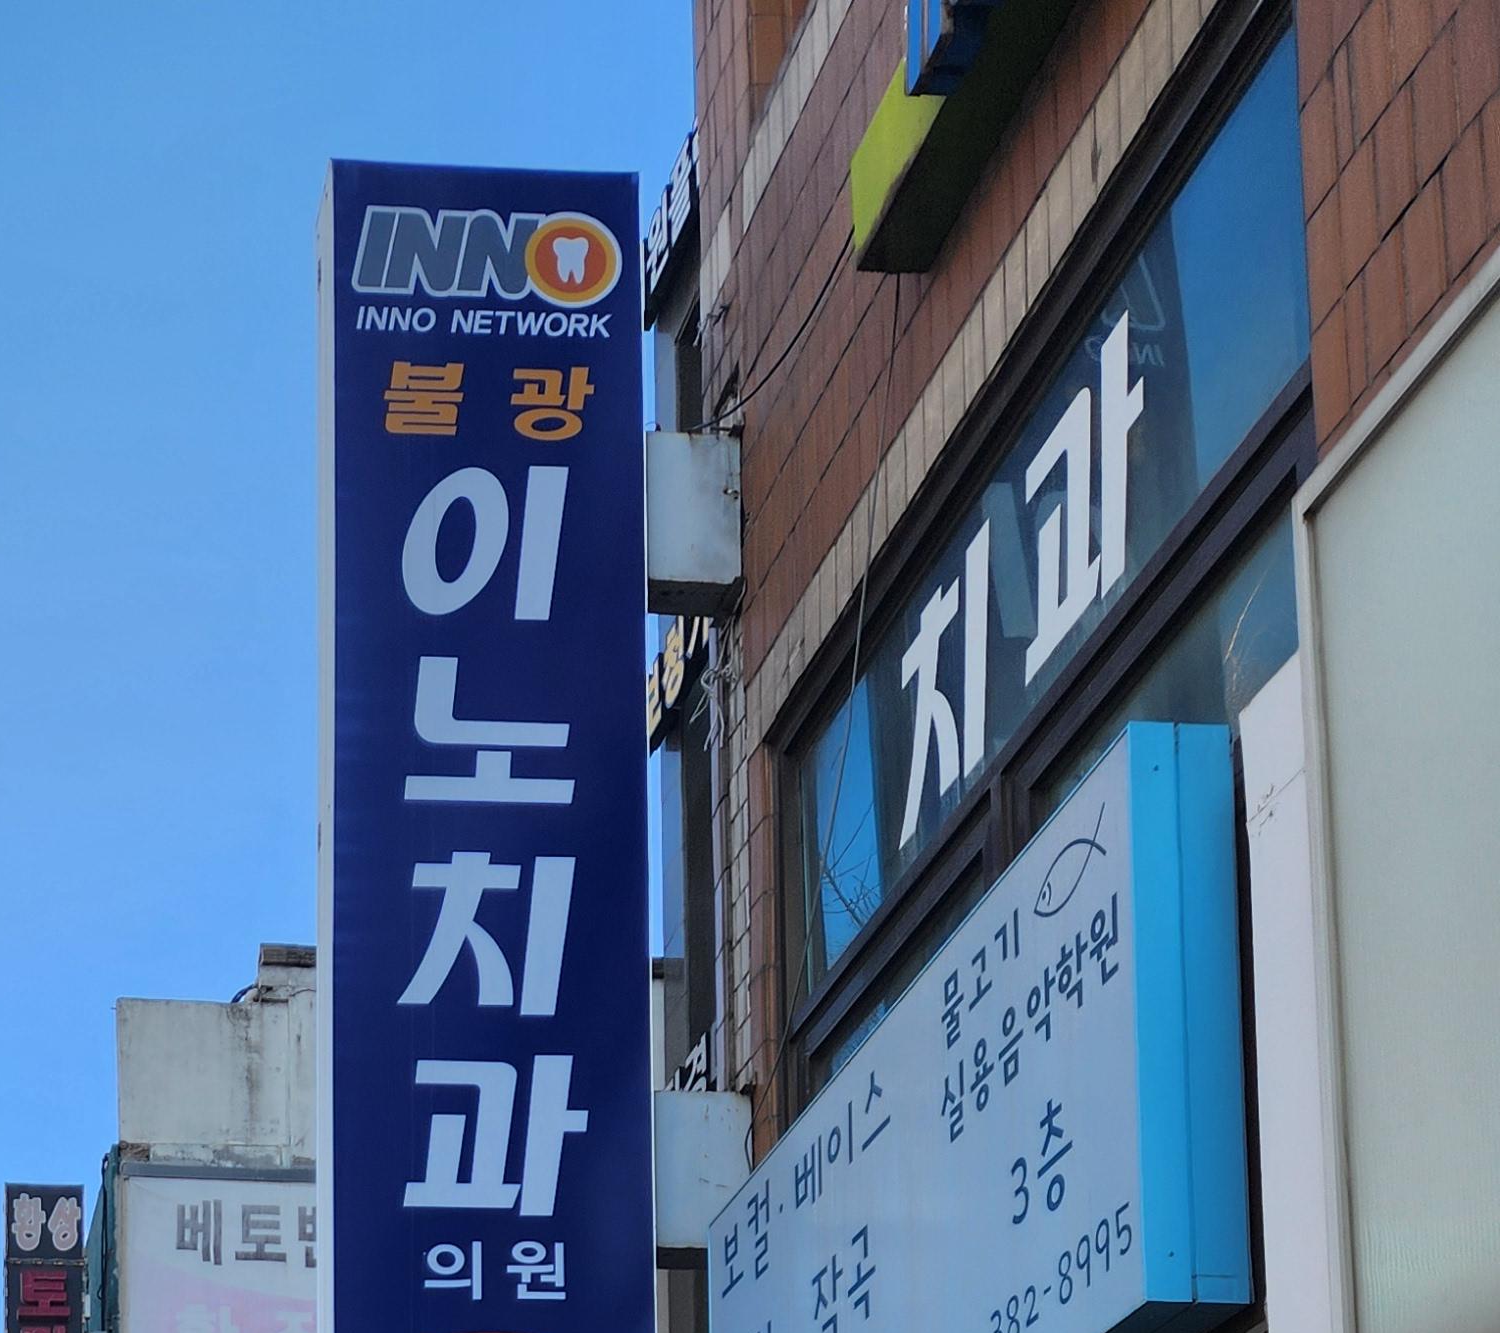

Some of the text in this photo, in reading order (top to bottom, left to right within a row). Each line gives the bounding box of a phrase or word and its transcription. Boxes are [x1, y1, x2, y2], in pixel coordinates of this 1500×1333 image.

[357, 305, 613, 338] INNO NETWORK
[899, 309, 1144, 851] 치과
[399, 465, 589, 1216] 이노치과
[939, 893, 1120, 1143] 실용음악학원
[941, 908, 1020, 1047] 물고기
[1012, 1101, 1073, 1225] 3층
[424, 1240, 568, 1301] 의원
